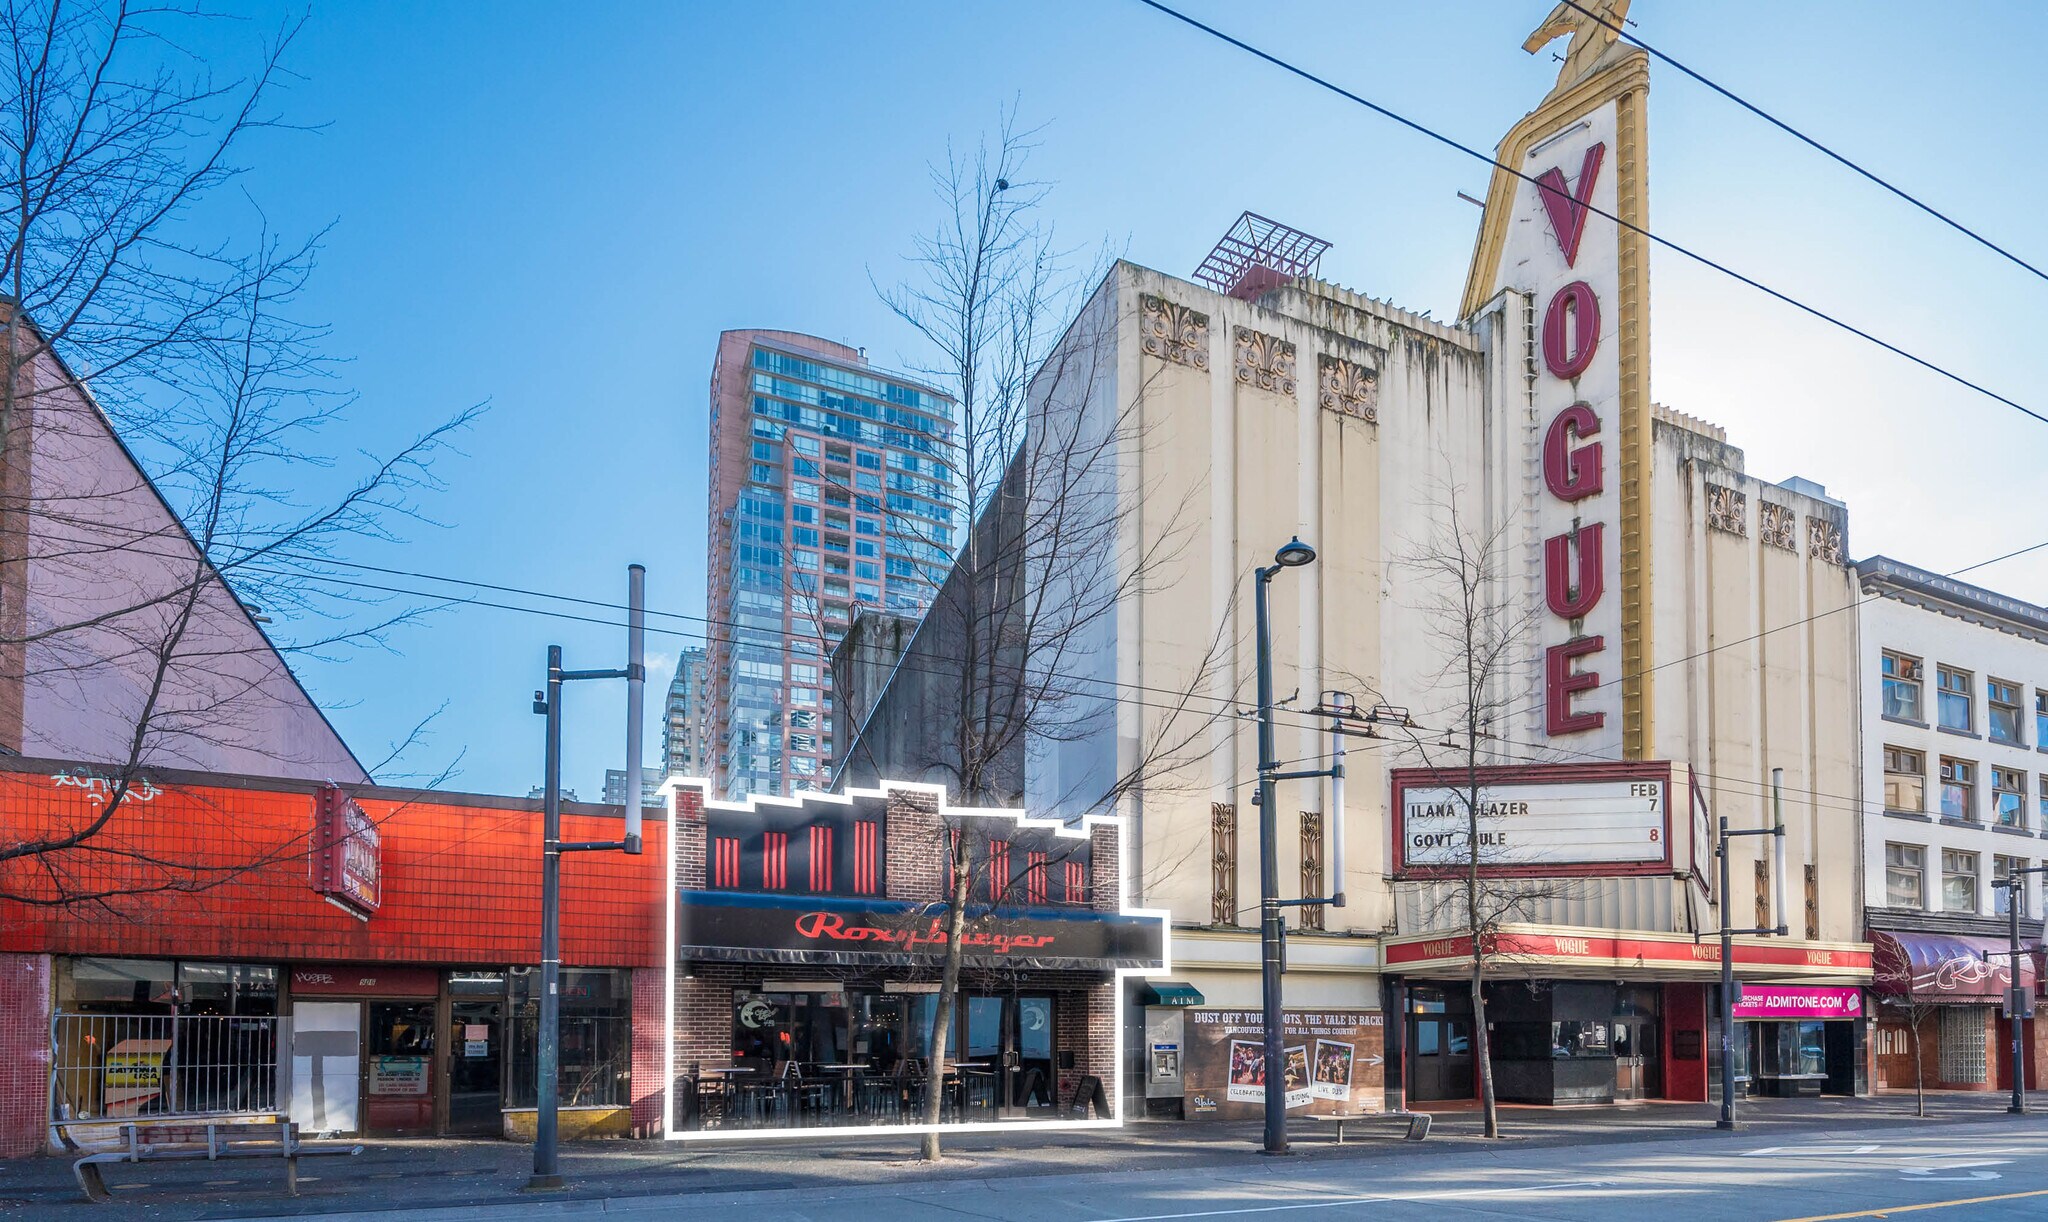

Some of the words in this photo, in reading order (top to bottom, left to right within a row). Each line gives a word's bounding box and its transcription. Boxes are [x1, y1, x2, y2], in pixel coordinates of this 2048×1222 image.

[1535, 141, 1605, 736] VOGUE
[1631, 784, 1658, 797] FEB
[1411, 804, 1455, 818] ILANA
[1649, 799, 1658, 811] 7
[1413, 833, 1454, 847] GOVT
[1649, 829, 1659, 842] 8
[1422, 940, 1455, 957] VOGUE
[1555, 938, 1589, 955] VOGUE
[1691, 945, 1721, 960] VOGUE
[1806, 951, 1832, 965] VOGUE
[1765, 996, 1842, 1008] ADMITONE.COM
[1194, 1012, 1219, 1024] DUST
[1222, 1012, 1242, 1024] OFF
[1244, 1013, 1265, 1024] YOU
[1282, 1013, 1302, 1025] OTS,
[1304, 1014, 1322, 1025] THE
[1324, 1014, 1346, 1025] YALE
[1348, 1015, 1357, 1025] IS
[1311, 1027, 1331, 1035] THINGS
[1331, 1027, 1358, 1035] COUNTRY
